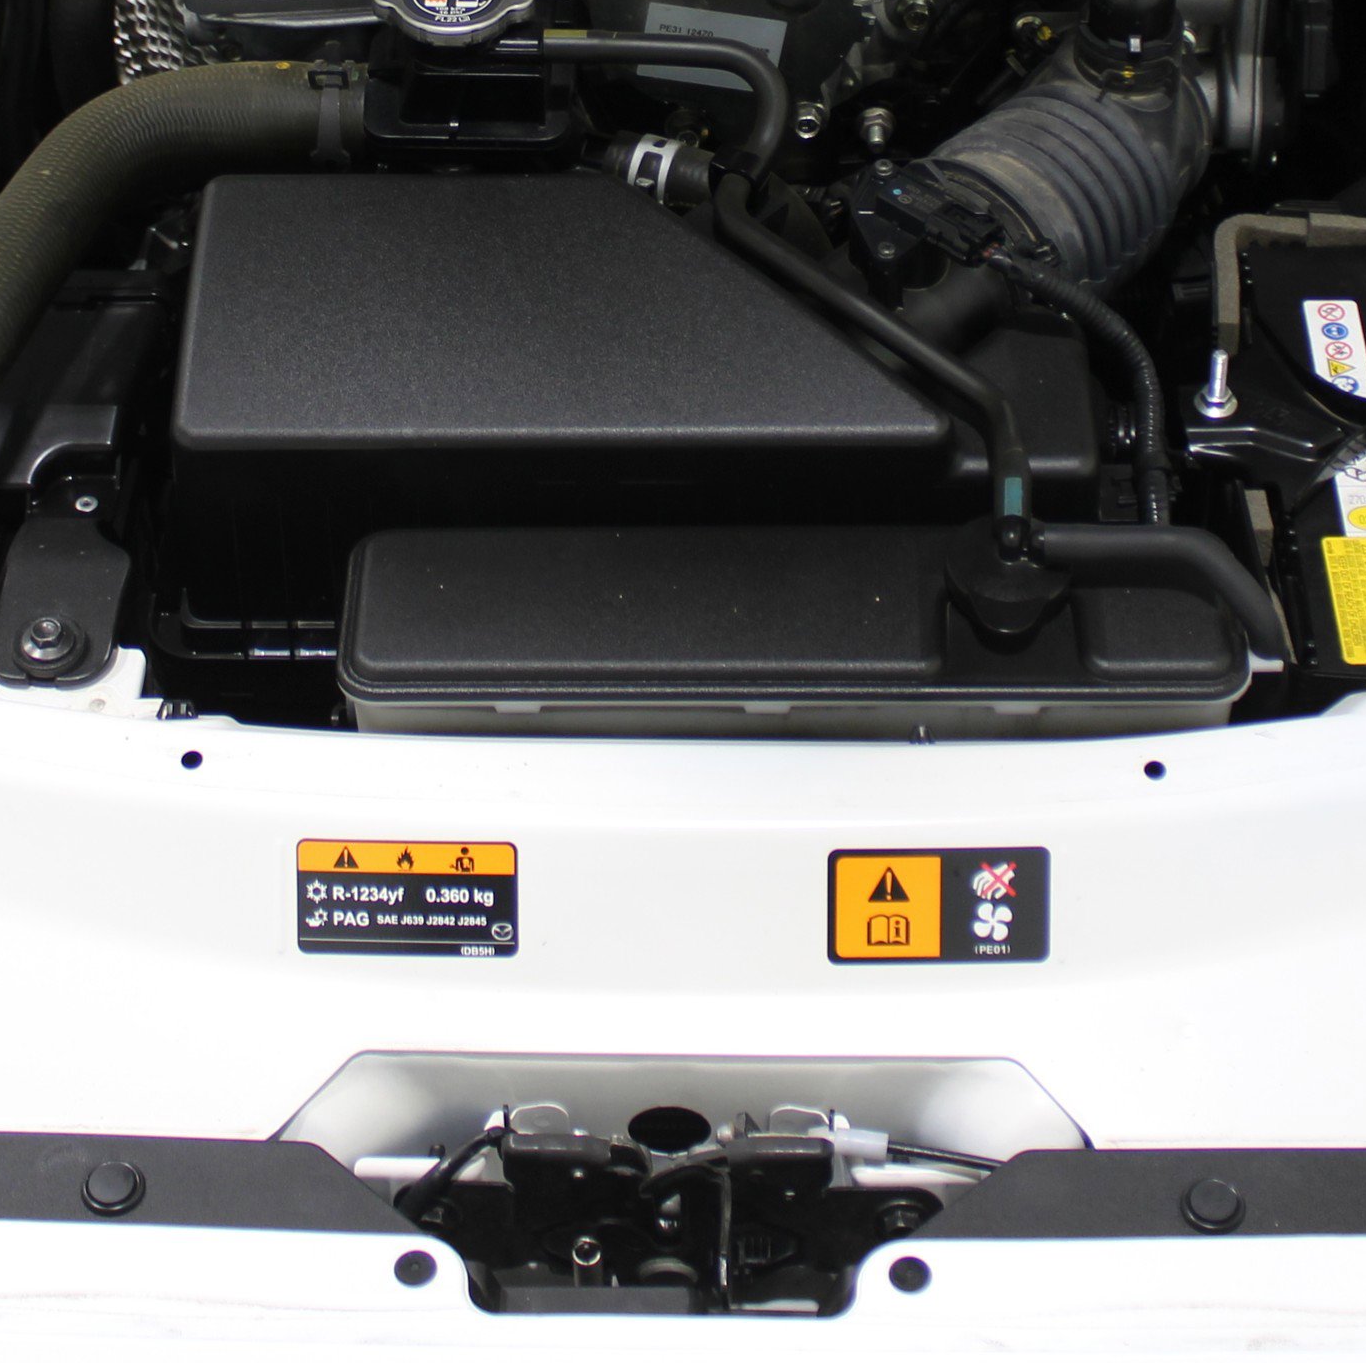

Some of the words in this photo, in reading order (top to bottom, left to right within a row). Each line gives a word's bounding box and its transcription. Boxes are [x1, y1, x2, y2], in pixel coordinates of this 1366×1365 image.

[659, 23, 683, 34] PE31
[332, 886, 404, 906] R-1234yf
[425, 888, 469, 904] 0.360
[474, 889, 495, 907] kg
[333, 911, 370, 927] PAG
[376, 914, 398, 925] SAE
[400, 914, 424, 926] J639
[426, 914, 455, 926] J2842
[457, 915, 487, 927] J2845
[974, 944, 1012, 955] (PE01)
